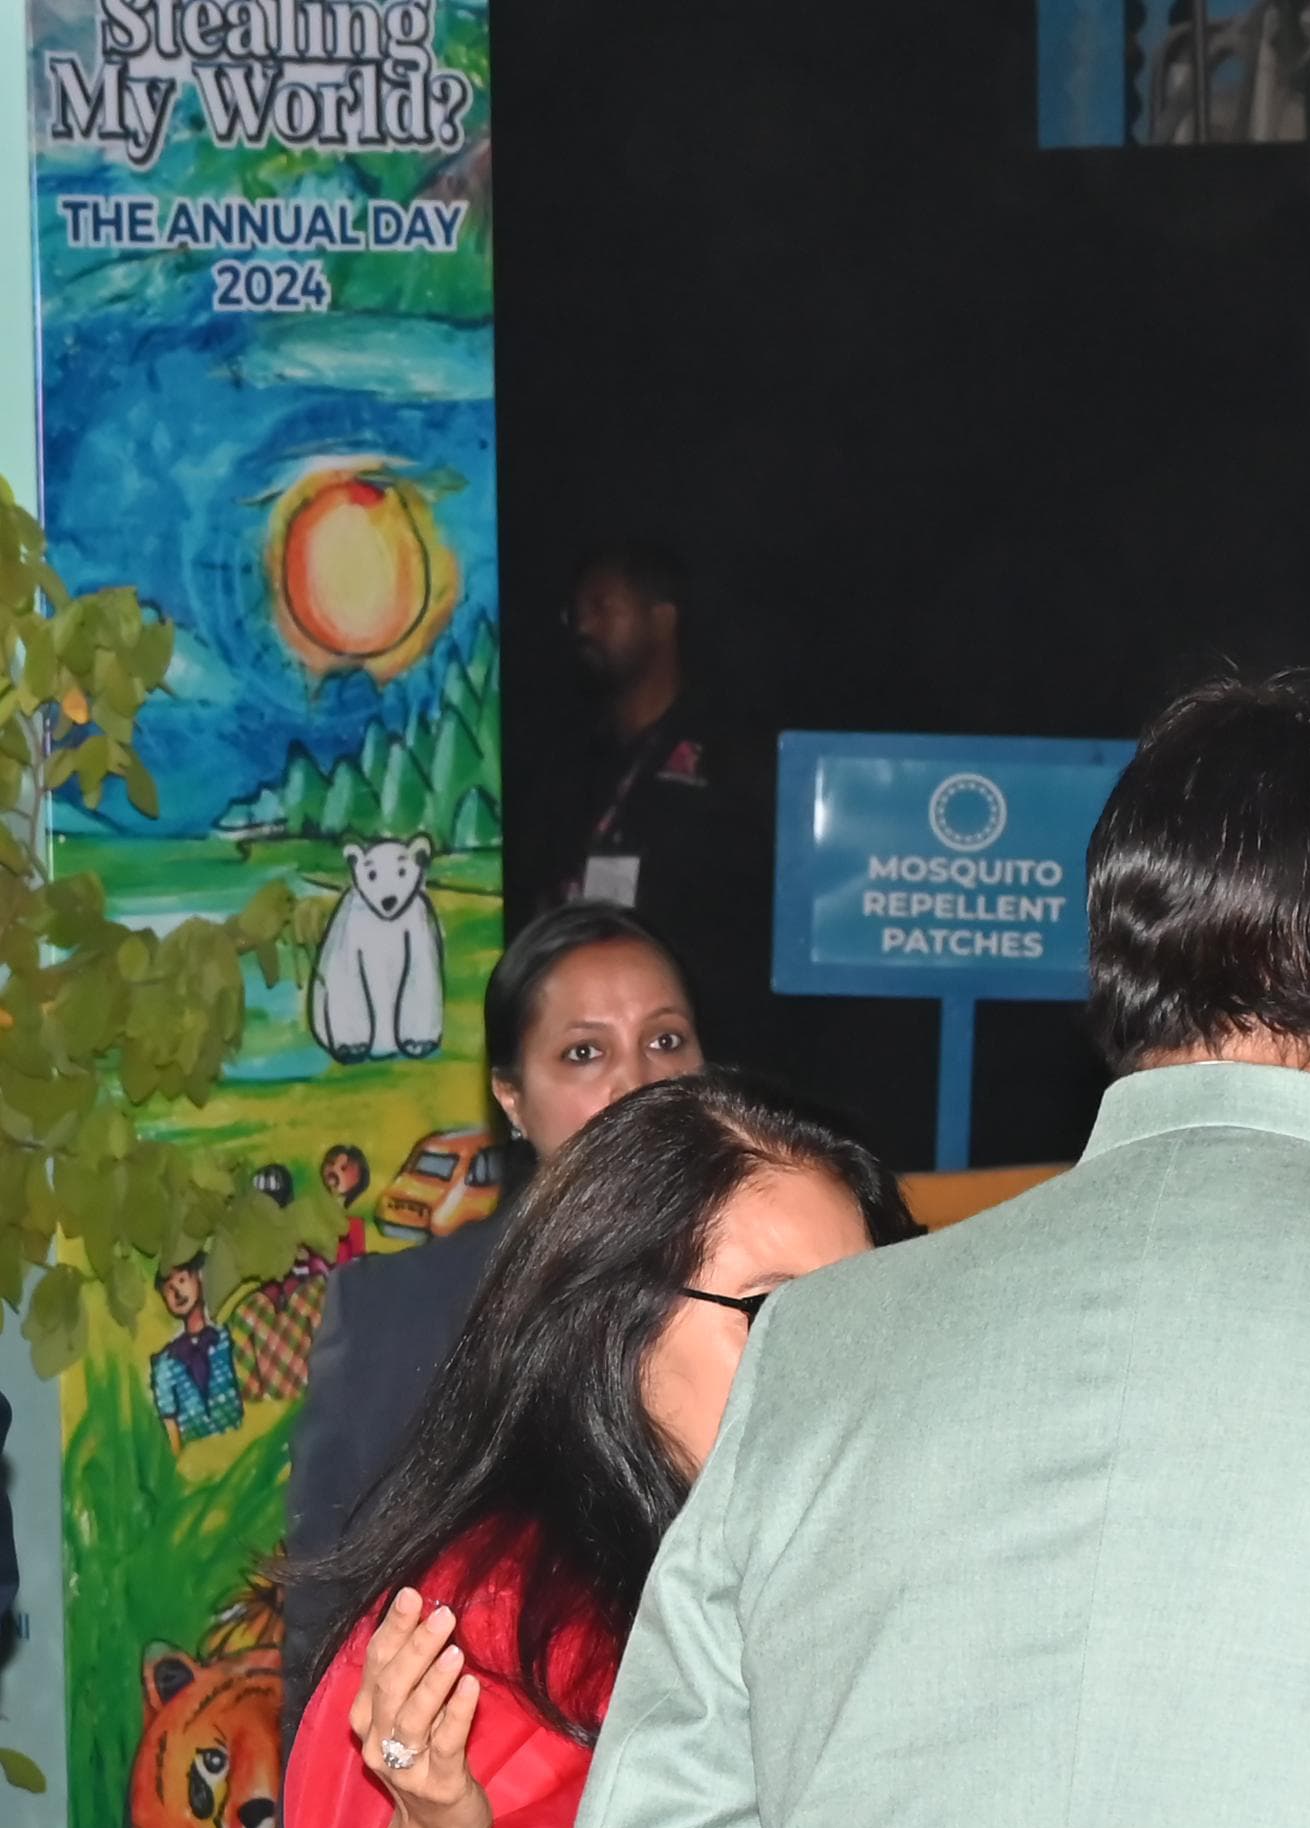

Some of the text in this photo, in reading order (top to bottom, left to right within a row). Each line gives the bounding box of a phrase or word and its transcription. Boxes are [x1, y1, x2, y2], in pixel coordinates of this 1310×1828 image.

[101, 0, 432, 84] Stealing
[50, 57, 468, 166] My World?
[62, 202, 463, 248] THE ANNUAL DAY
[216, 266, 328, 307] 2024
[868, 855, 1063, 888] MOSQUITO
[863, 892, 1066, 922] REPELLENT
[882, 928, 1044, 958] PATCHES
